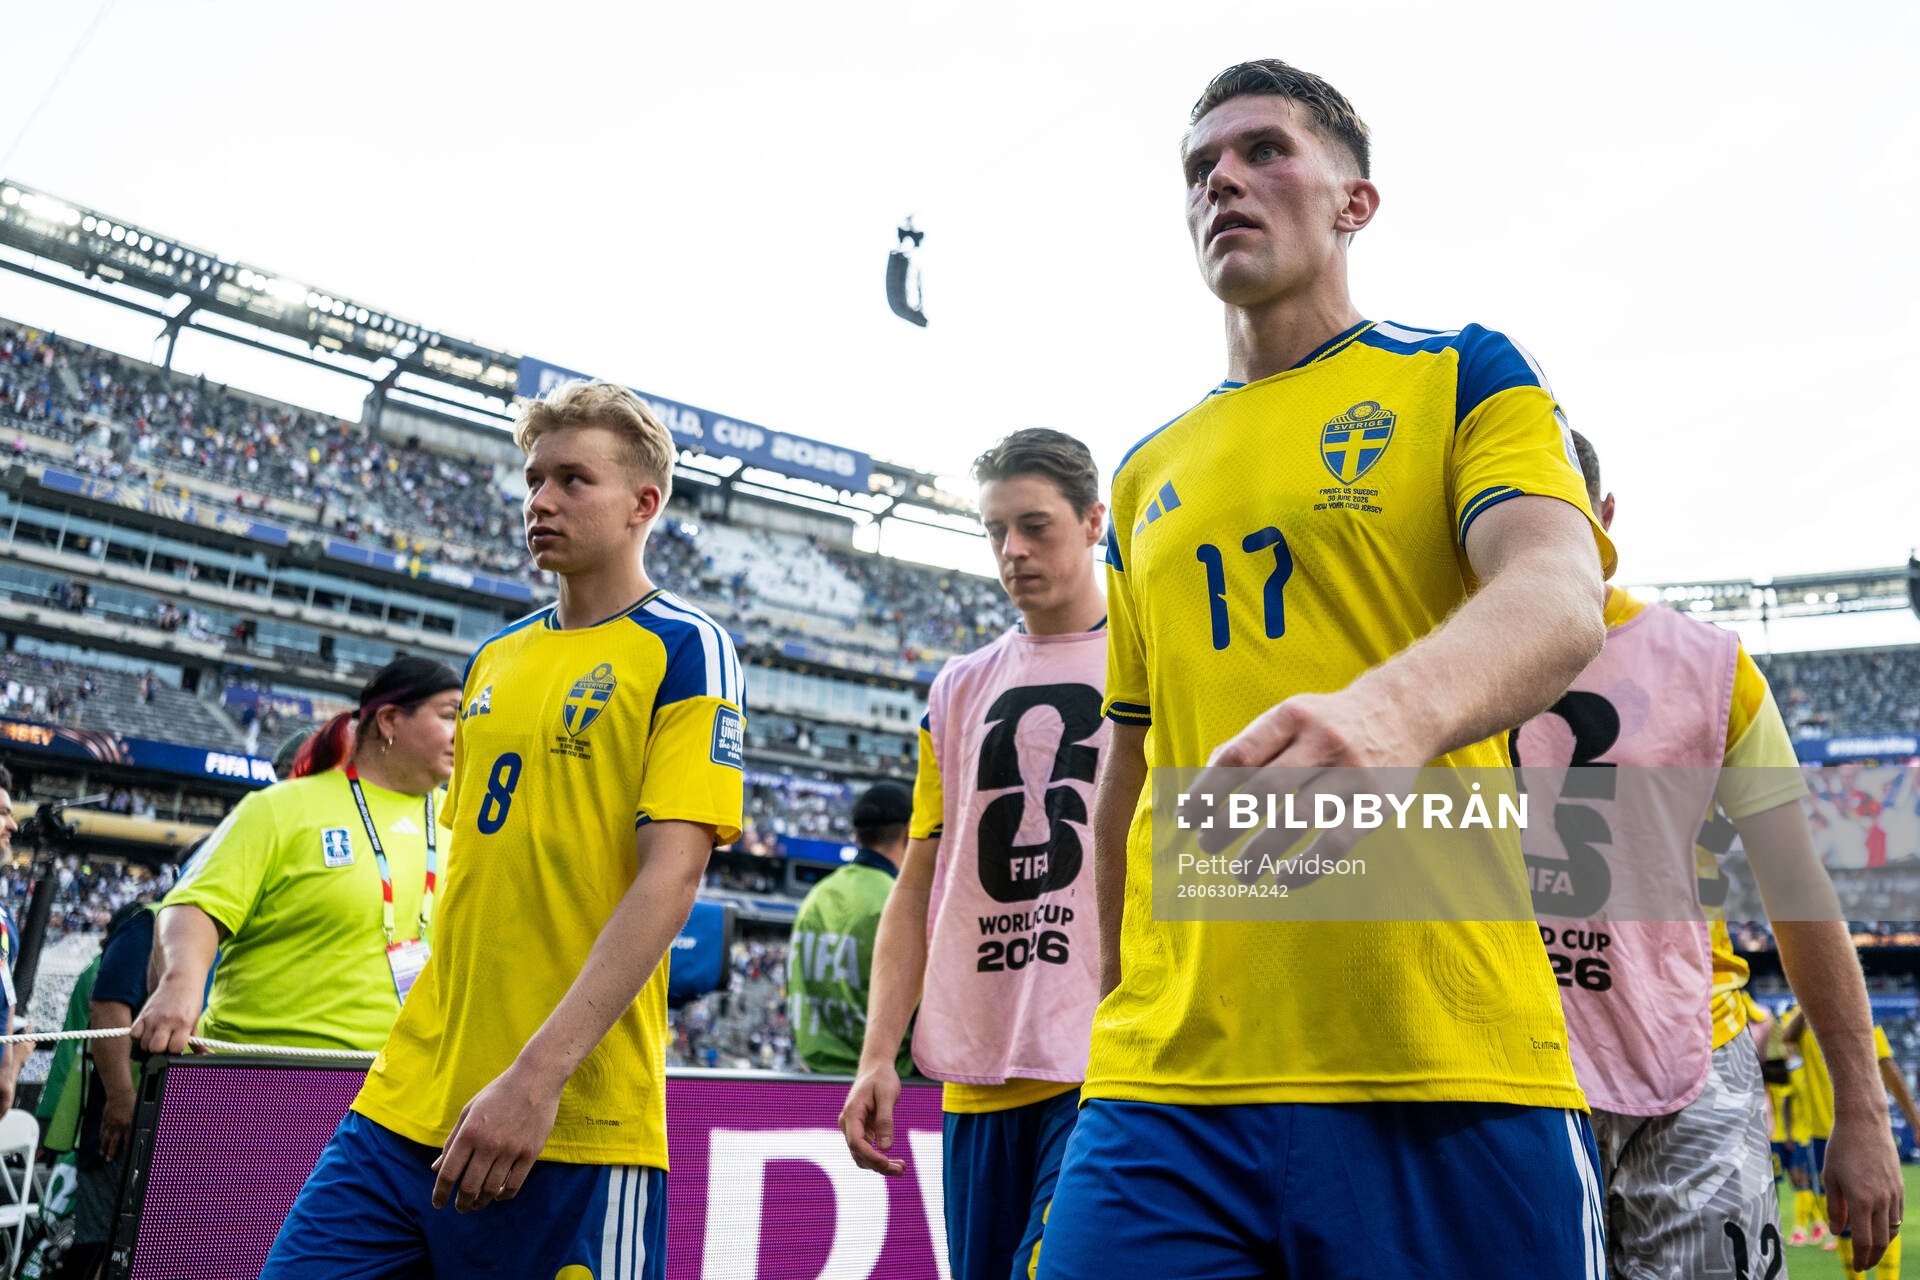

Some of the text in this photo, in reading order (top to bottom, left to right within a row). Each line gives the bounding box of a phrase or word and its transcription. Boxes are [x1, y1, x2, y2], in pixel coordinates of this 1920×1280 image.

[1334, 420, 1384, 431] SVERIGE
[713, 420, 764, 450] CUP
[771, 435, 855, 475] 2026
[1320, 487, 1342, 495] FRANCE
[1353, 488, 1378, 497] SWEDEN
[1314, 503, 1328, 511] NEW
[1346, 502, 1360, 510] NEW
[1361, 505, 1382, 514] JERSEY
[1196, 526, 1293, 651] 17
[721, 725, 742, 742] UNIT
[722, 716, 741, 729] FOOT
[205, 751, 250, 779] FIFA
[477, 752, 523, 836] 8
[1527, 866, 1575, 896] IFA
[978, 910, 1037, 936] WORL
[1539, 926, 1611, 952] D CUP
[788, 931, 861, 988] FIFA
[1547, 952, 1613, 992] 26
[1724, 1221, 1783, 1280] 12
